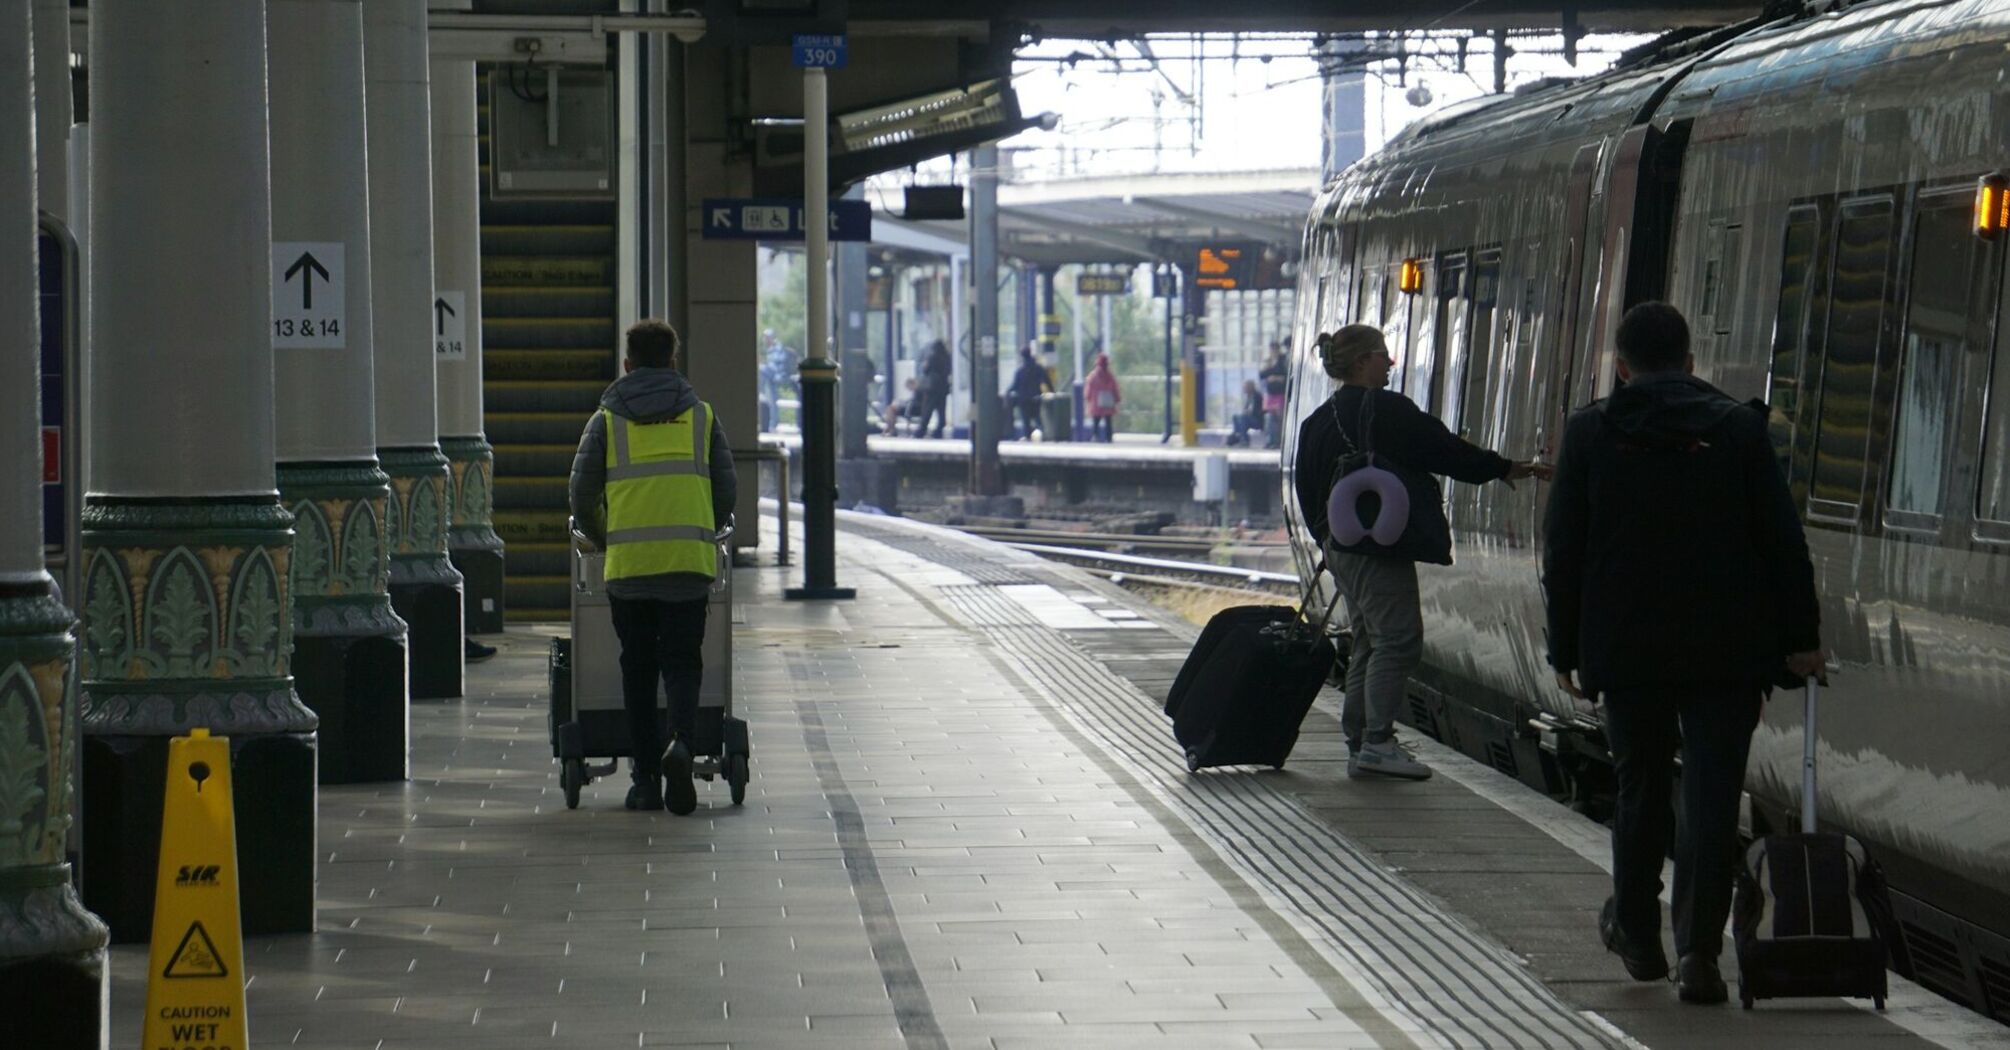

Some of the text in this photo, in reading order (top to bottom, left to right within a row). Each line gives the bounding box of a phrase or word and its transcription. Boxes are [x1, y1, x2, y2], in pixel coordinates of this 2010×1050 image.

[804, 48, 836, 65] 390
[798, 208, 839, 231] Lt
[275, 319, 340, 336] 13 & 14
[437, 341, 462, 353] & 14
[160, 1006, 231, 1020] CAUTION
[172, 1023, 219, 1042] WET
